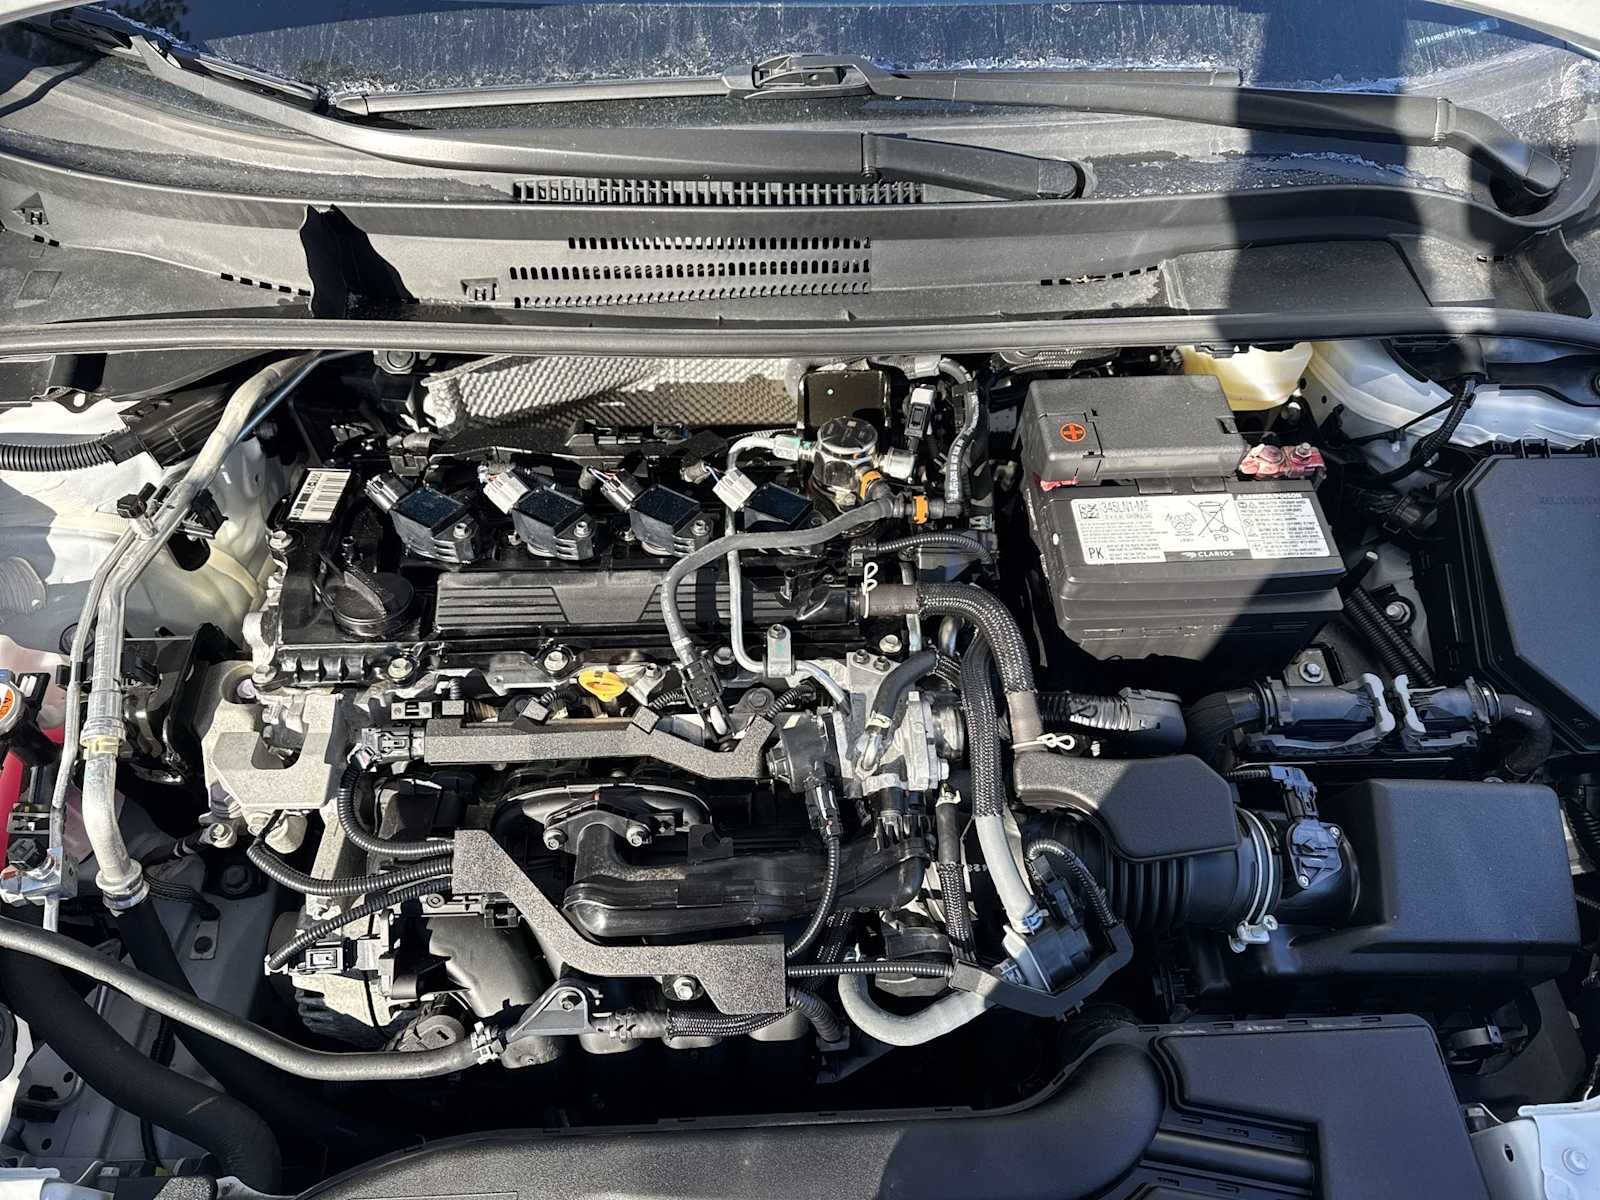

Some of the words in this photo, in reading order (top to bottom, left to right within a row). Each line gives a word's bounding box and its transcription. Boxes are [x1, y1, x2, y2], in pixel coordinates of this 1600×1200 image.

[1213, 533, 1229, 542] Pb
[1088, 546, 1104, 560] PK
[1198, 550, 1235, 558] CLARIOS
